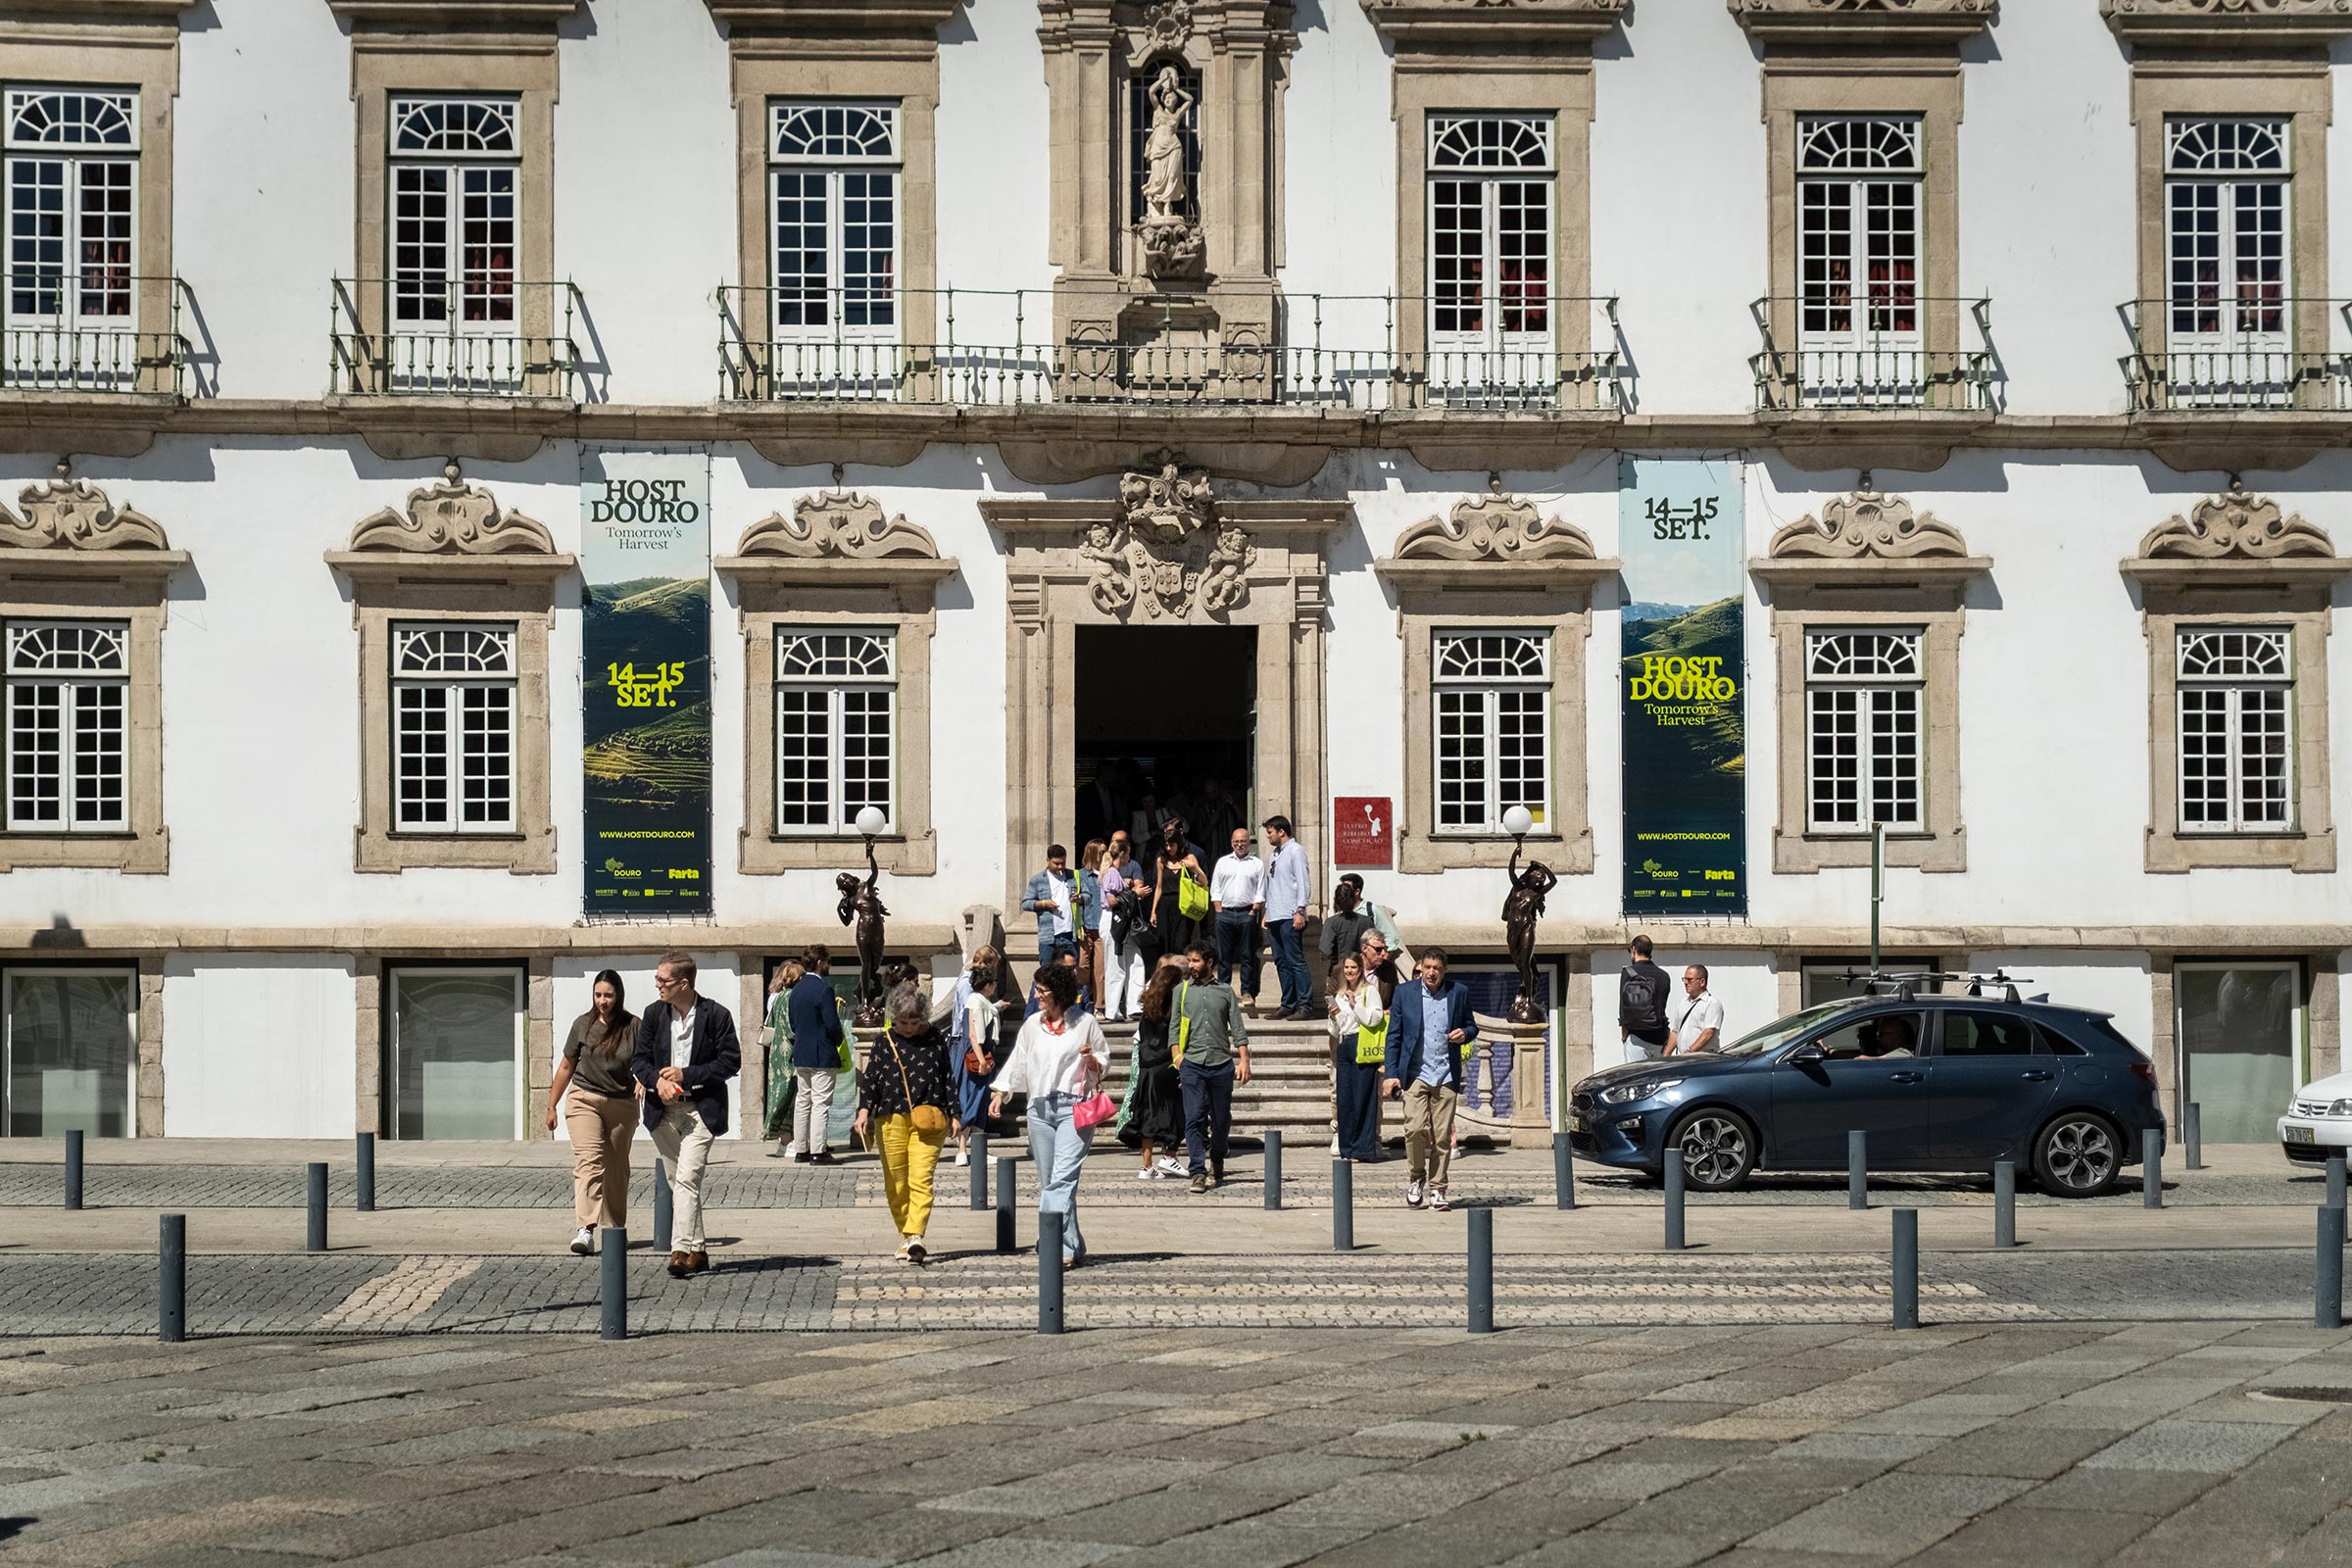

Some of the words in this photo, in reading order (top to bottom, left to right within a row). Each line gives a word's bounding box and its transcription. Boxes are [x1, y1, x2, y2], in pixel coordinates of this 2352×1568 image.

[604, 479, 686, 502] HOST
[591, 500, 699, 523] DOURO
[1653, 517, 1710, 540] SET.
[619, 538, 668, 550] Harvest
[1642, 656, 1723, 679] HOST
[616, 683, 676, 707] SET.
[1630, 676, 1736, 701] DOURO
[1657, 714, 1706, 725] Harvest
[668, 868, 700, 879] Farta
[1704, 869, 1735, 880] Farta
[1362, 1047, 1385, 1056] HOS
